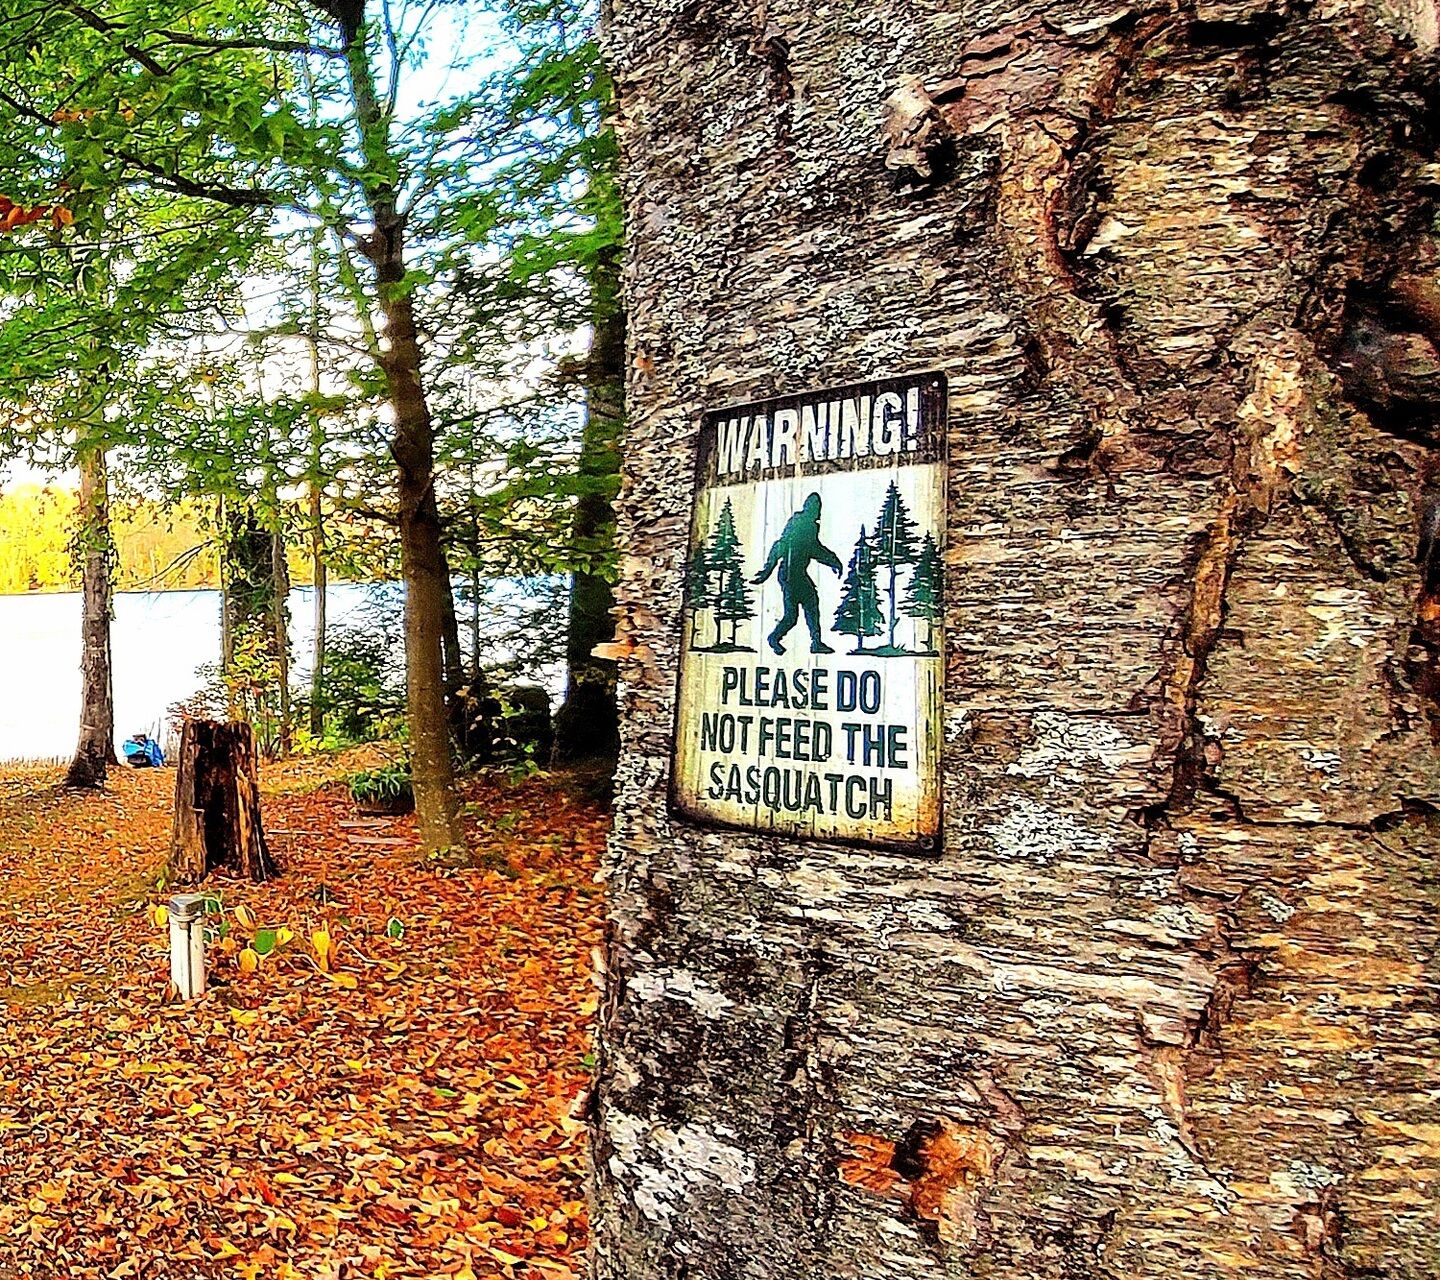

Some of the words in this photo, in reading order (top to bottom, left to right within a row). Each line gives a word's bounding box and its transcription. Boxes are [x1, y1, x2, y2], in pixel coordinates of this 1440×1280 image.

[717, 387, 919, 475] WARNING!
[721, 666, 828, 710] PLEASE
[836, 670, 881, 714] DO
[700, 713, 753, 754] NOT
[759, 716, 832, 762] FEED
[841, 723, 908, 769] THE
[709, 762, 892, 821] SASQUATCH
